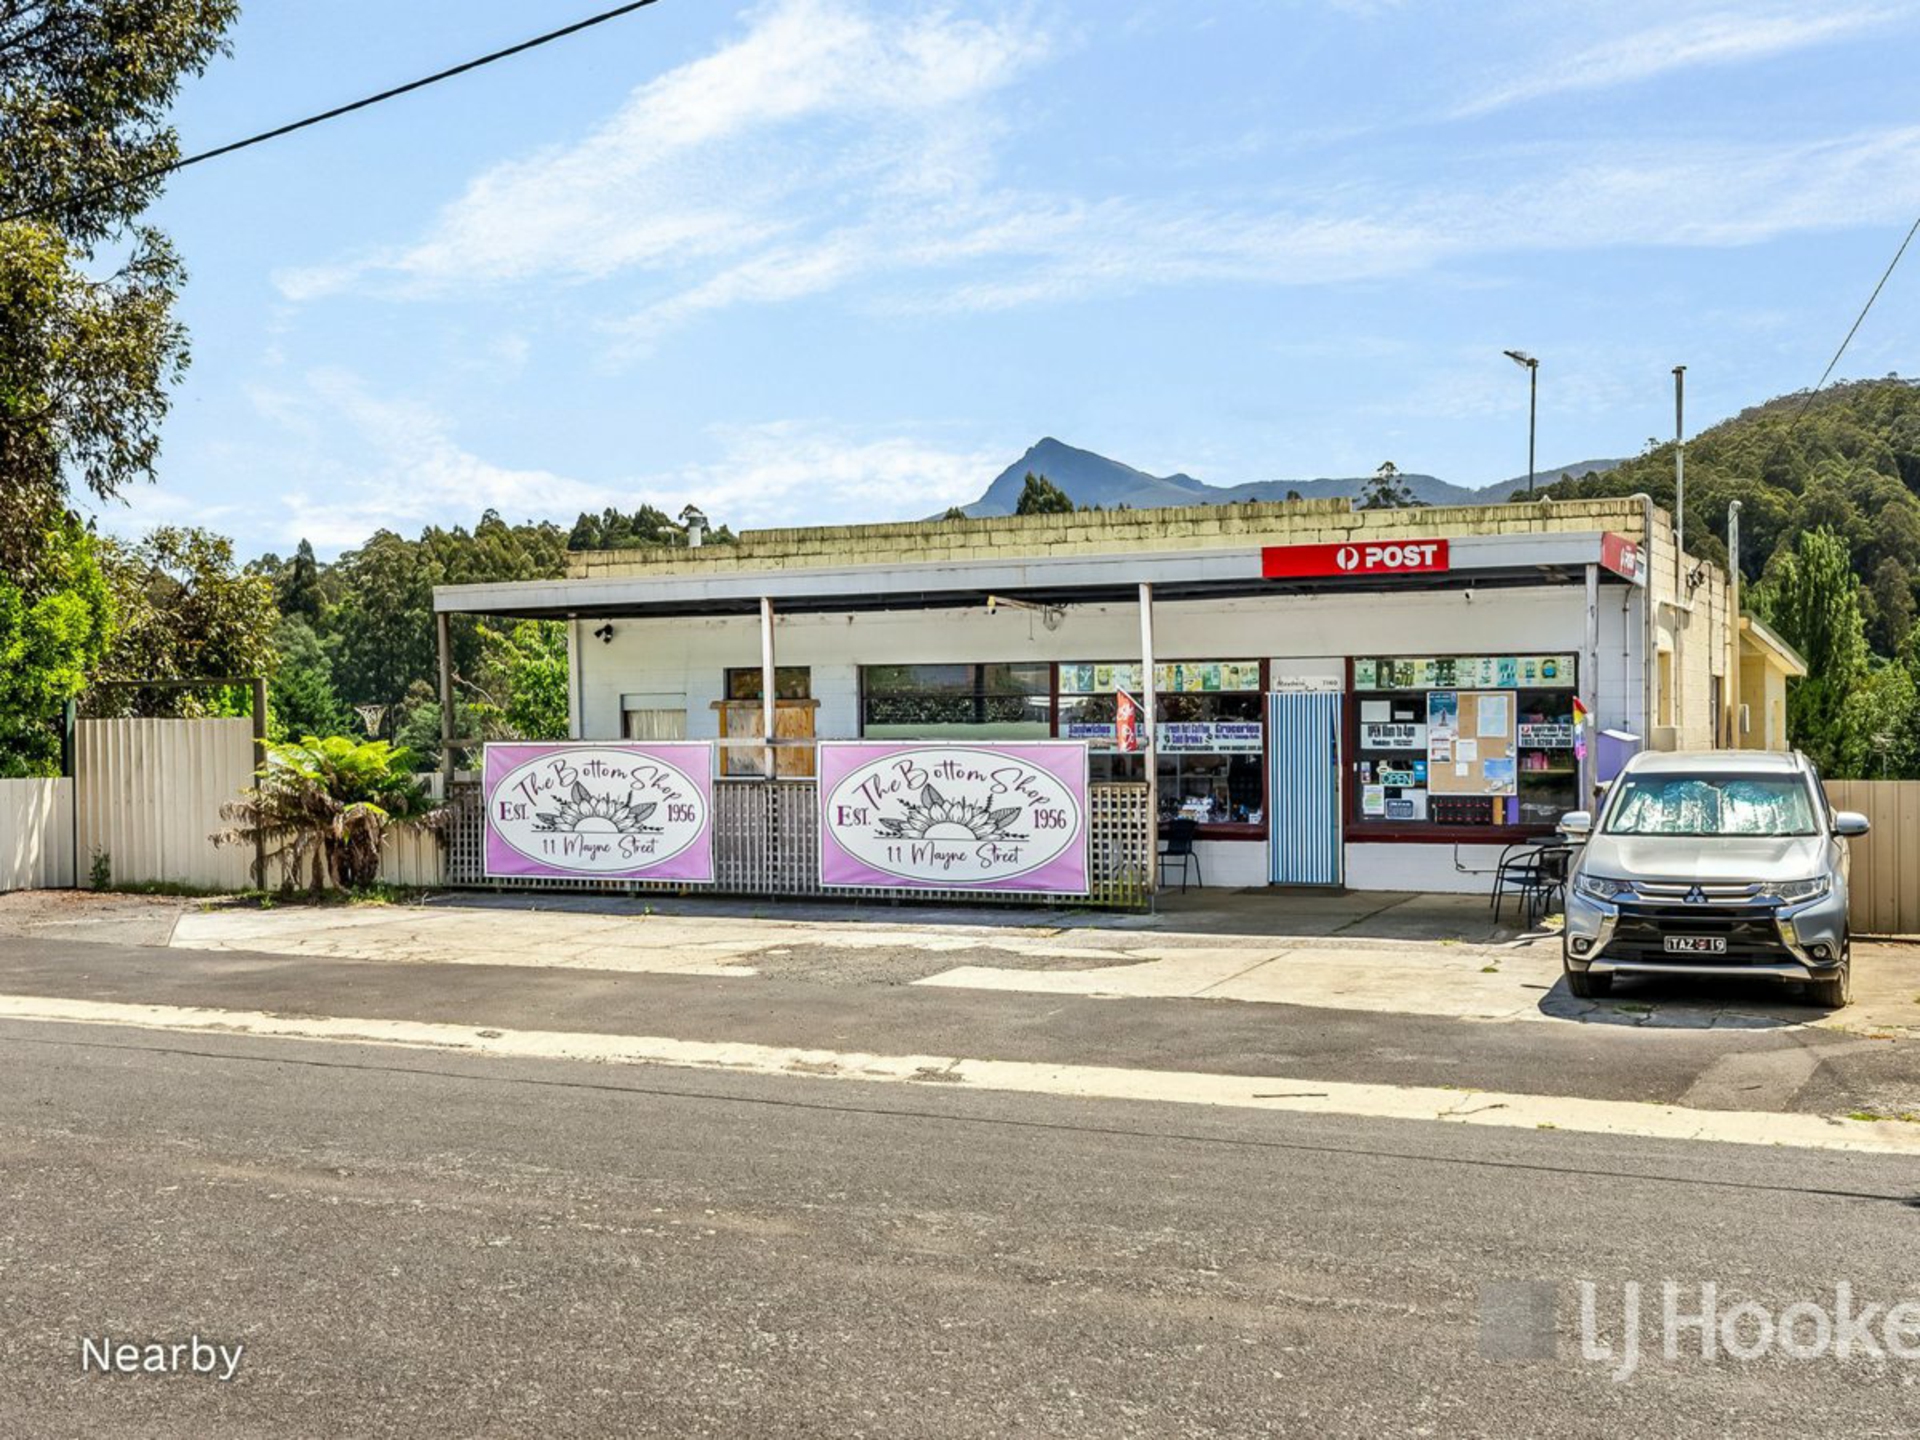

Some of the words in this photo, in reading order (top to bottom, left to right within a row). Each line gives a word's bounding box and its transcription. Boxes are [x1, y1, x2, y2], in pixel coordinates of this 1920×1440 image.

[1366, 544, 1437, 568] POST
[1215, 723, 1260, 733] Groceries
[512, 771, 554, 807] The
[547, 759, 628, 788] Bottom
[630, 766, 682, 802] Shop
[852, 773, 902, 811] The
[892, 759, 988, 791] Bottom
[990, 767, 1051, 807] Shop
[1382, 772, 1411, 785] OPEN
[667, 804, 696, 822] 1956
[1034, 808, 1068, 830] 1956
[542, 839, 556, 855] 11
[564, 834, 611, 860] Mayne
[617, 834, 660, 859] Street
[887, 846, 902, 863] 11
[911, 842, 968, 871] Mayne
[975, 842, 1025, 869] Street
